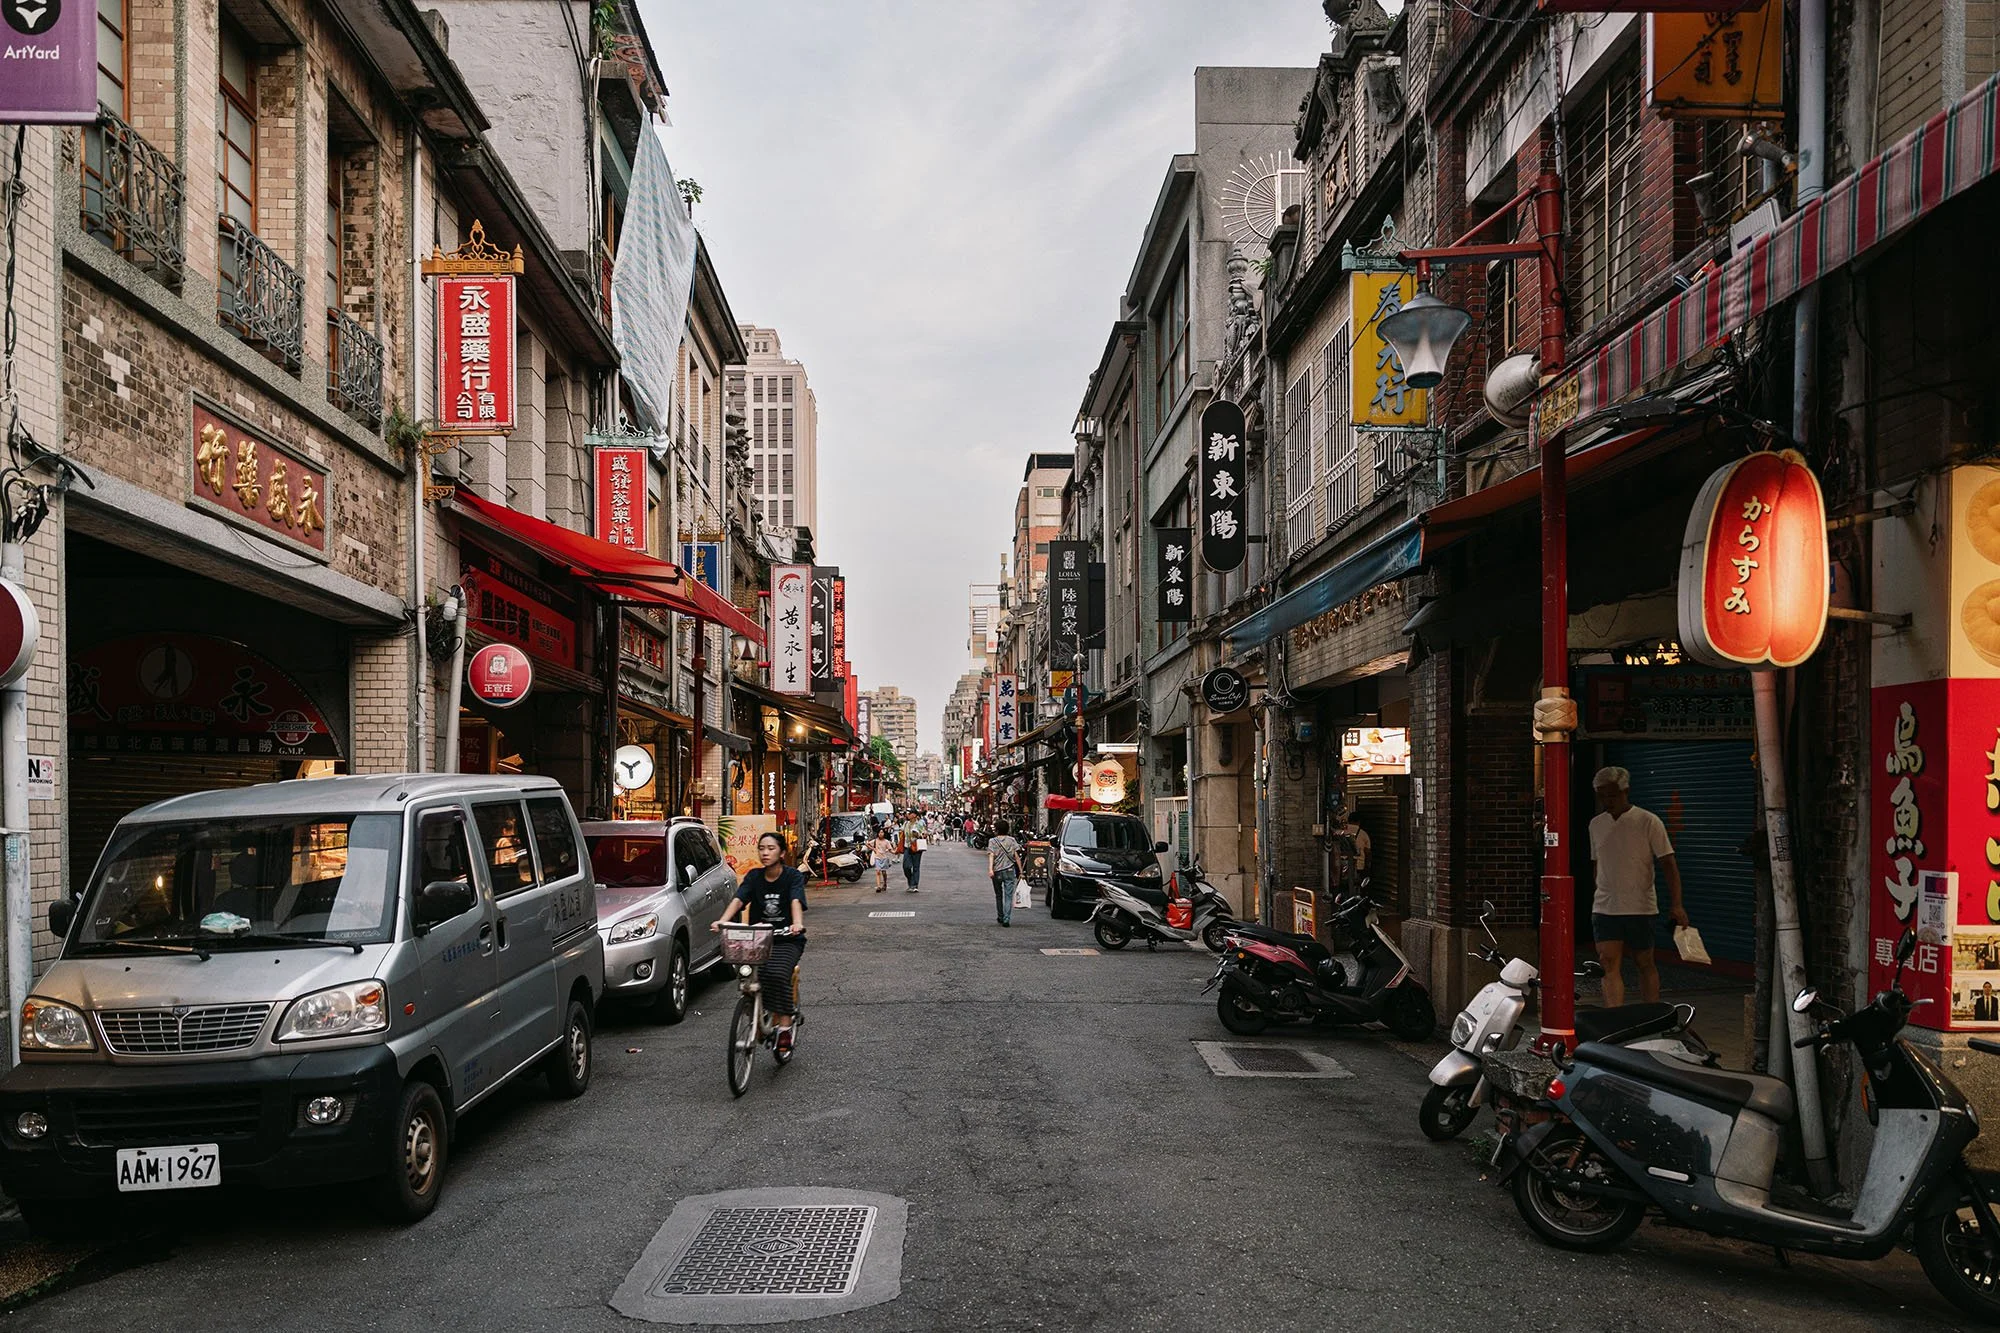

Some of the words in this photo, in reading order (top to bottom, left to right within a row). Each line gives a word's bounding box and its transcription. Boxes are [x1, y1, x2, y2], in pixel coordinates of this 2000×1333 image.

[3, 44, 60, 60] ArtYard
[459, 285, 491, 391] 永盛藥行
[457, 392, 473, 419] 公司
[479, 392, 496, 419] 有限
[1207, 432, 1240, 540] 新東陽
[1165, 544, 1185, 606] 新東陽
[1724, 495, 1771, 615] からすみ
[779, 605, 803, 684] 黃永生
[484, 684, 513, 693] 正官庄
[998, 679, 1015, 740] 萬安堂
[278, 747, 306, 756] G.M.P.
[1886, 701, 1924, 922] 烏魚子
